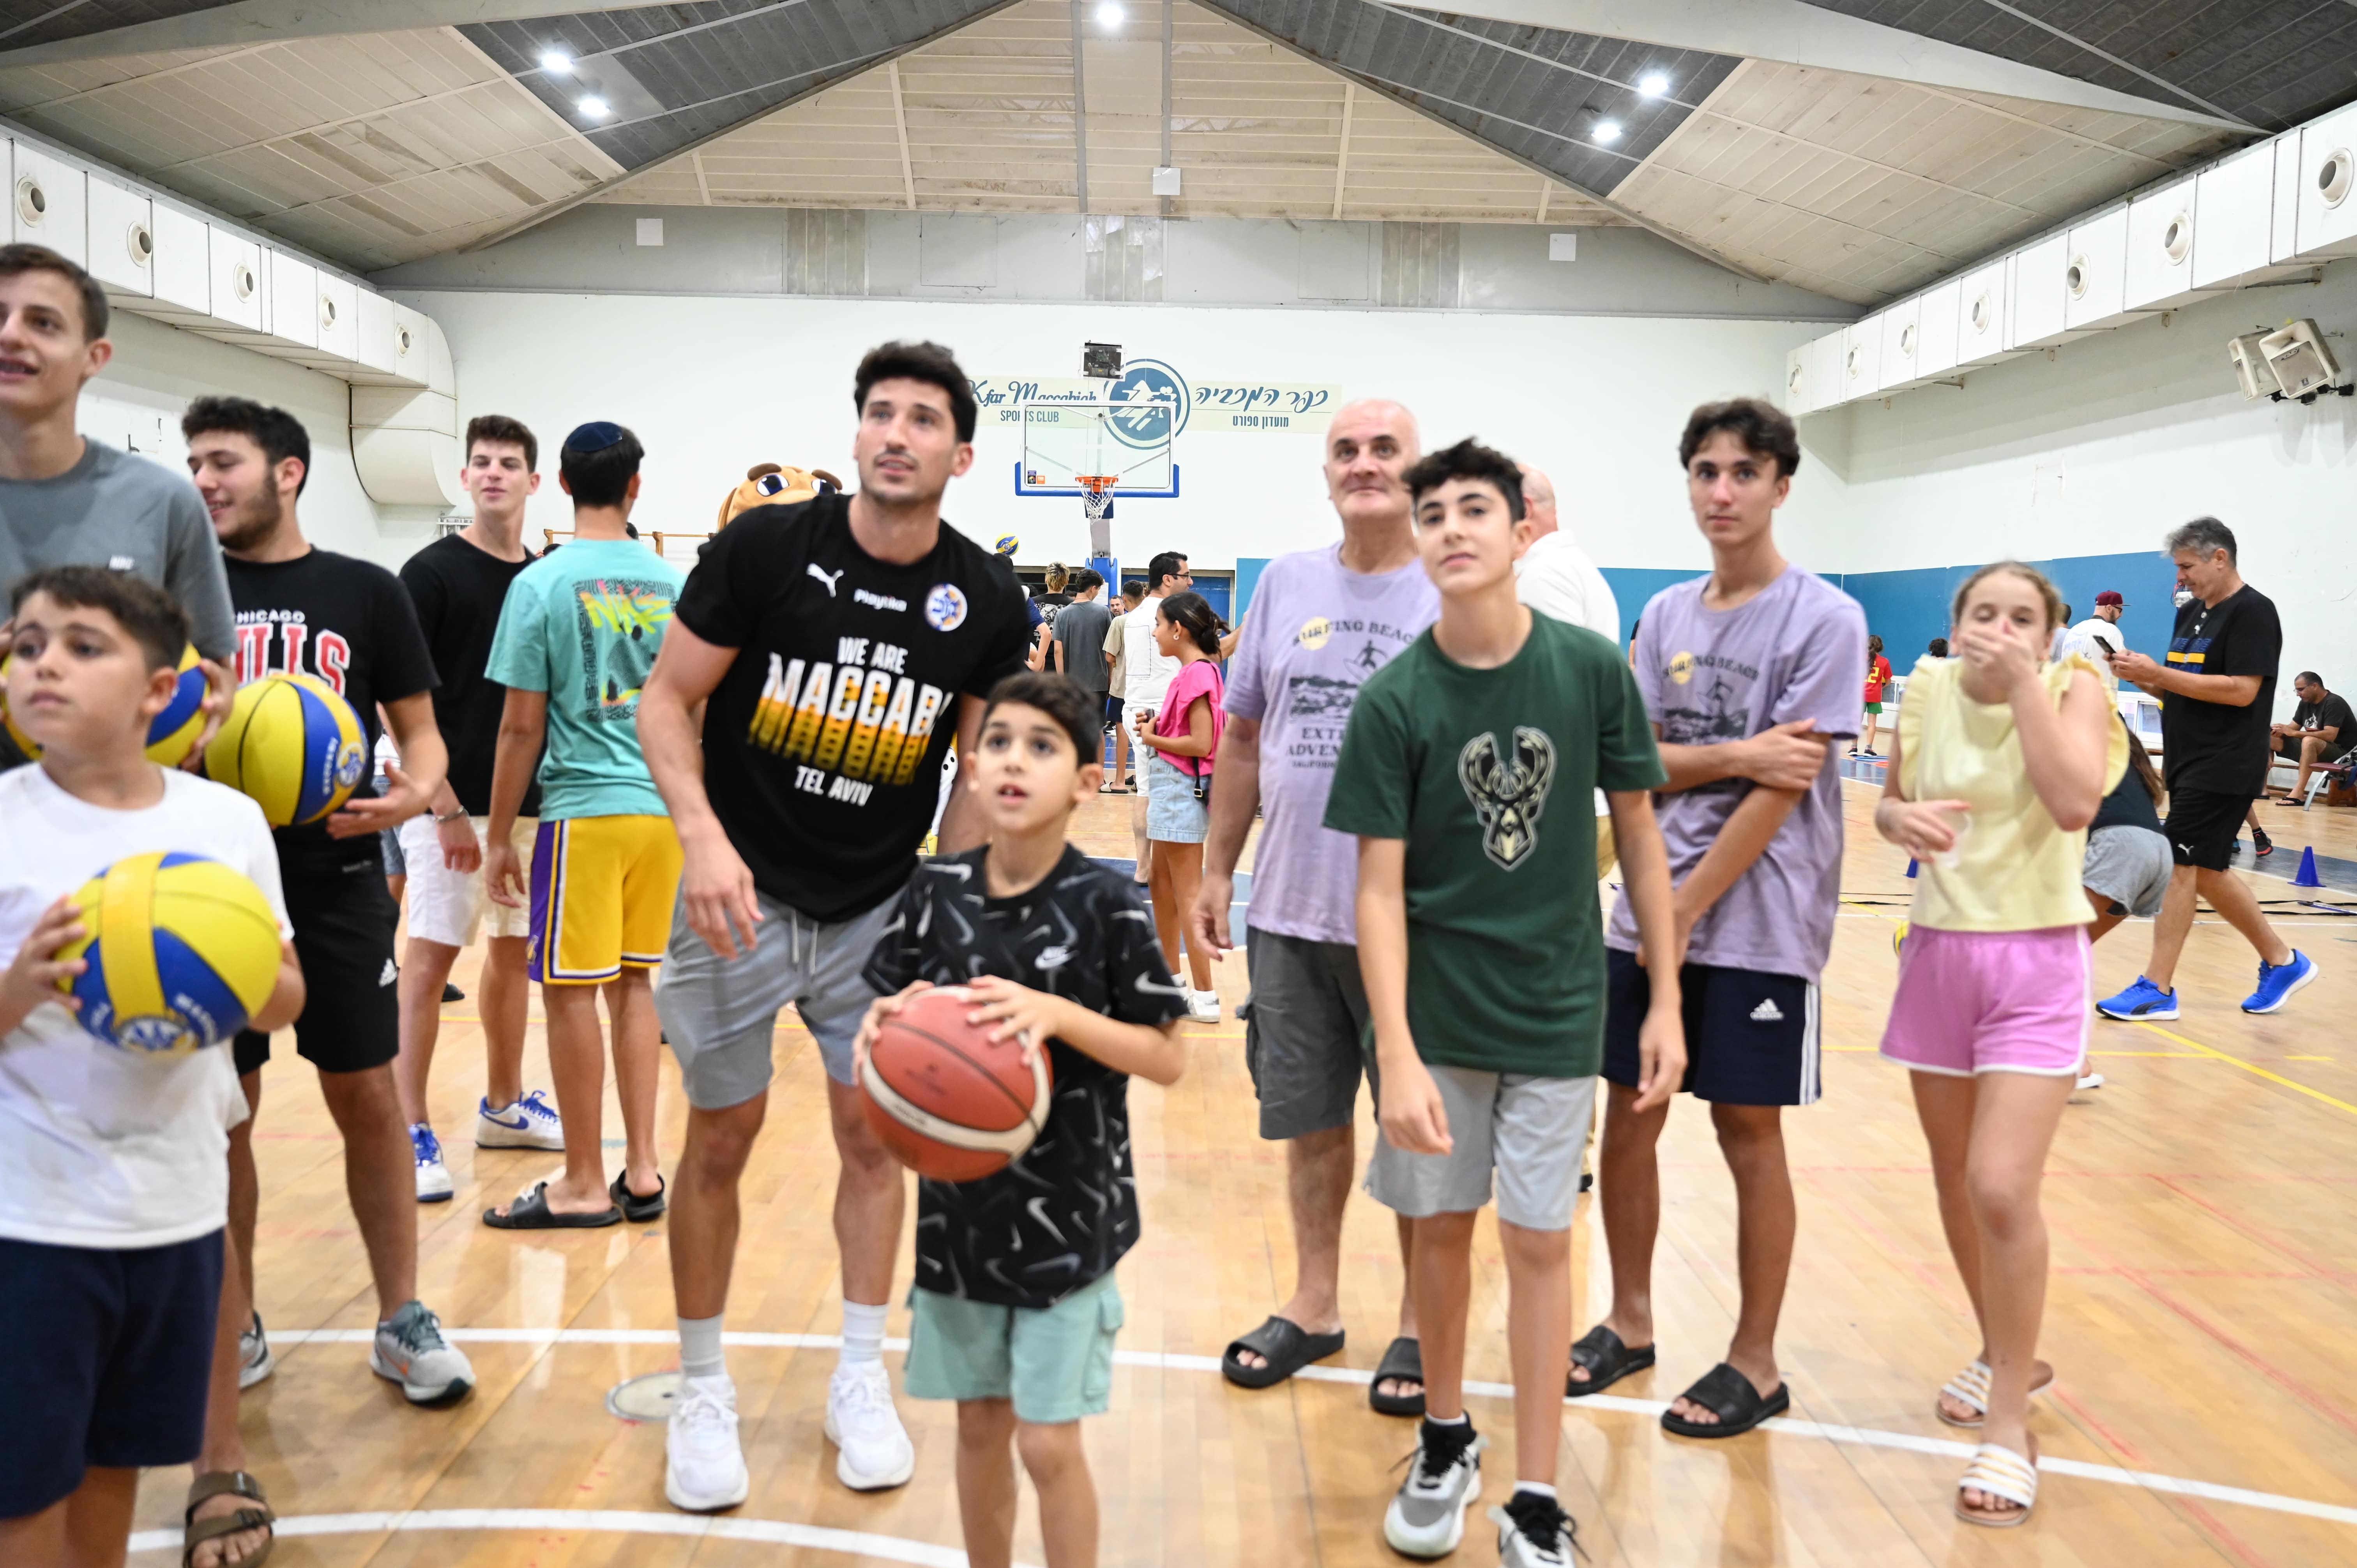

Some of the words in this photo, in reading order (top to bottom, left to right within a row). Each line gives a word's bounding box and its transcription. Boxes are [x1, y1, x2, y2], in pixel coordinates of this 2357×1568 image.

[966, 379, 1006, 407] Kfar
[1008, 381, 1096, 404] Maccabiah
[1194, 386, 1279, 412] המכביה
[1286, 390, 1328, 413] כפר
[1037, 411, 1059, 422] CLUB
[1233, 415, 1258, 426] ספורט
[1262, 416, 1289, 429] מועדון
[235, 609, 306, 624] HICAGO
[1368, 622, 1415, 644] BEAC
[230, 623, 351, 698] LLS
[837, 636, 870, 666] WE
[870, 642, 909, 675] ARE
[1864, 667, 1880, 683] 2
[794, 765, 824, 795] TEL
[828, 775, 873, 807] AVIV
